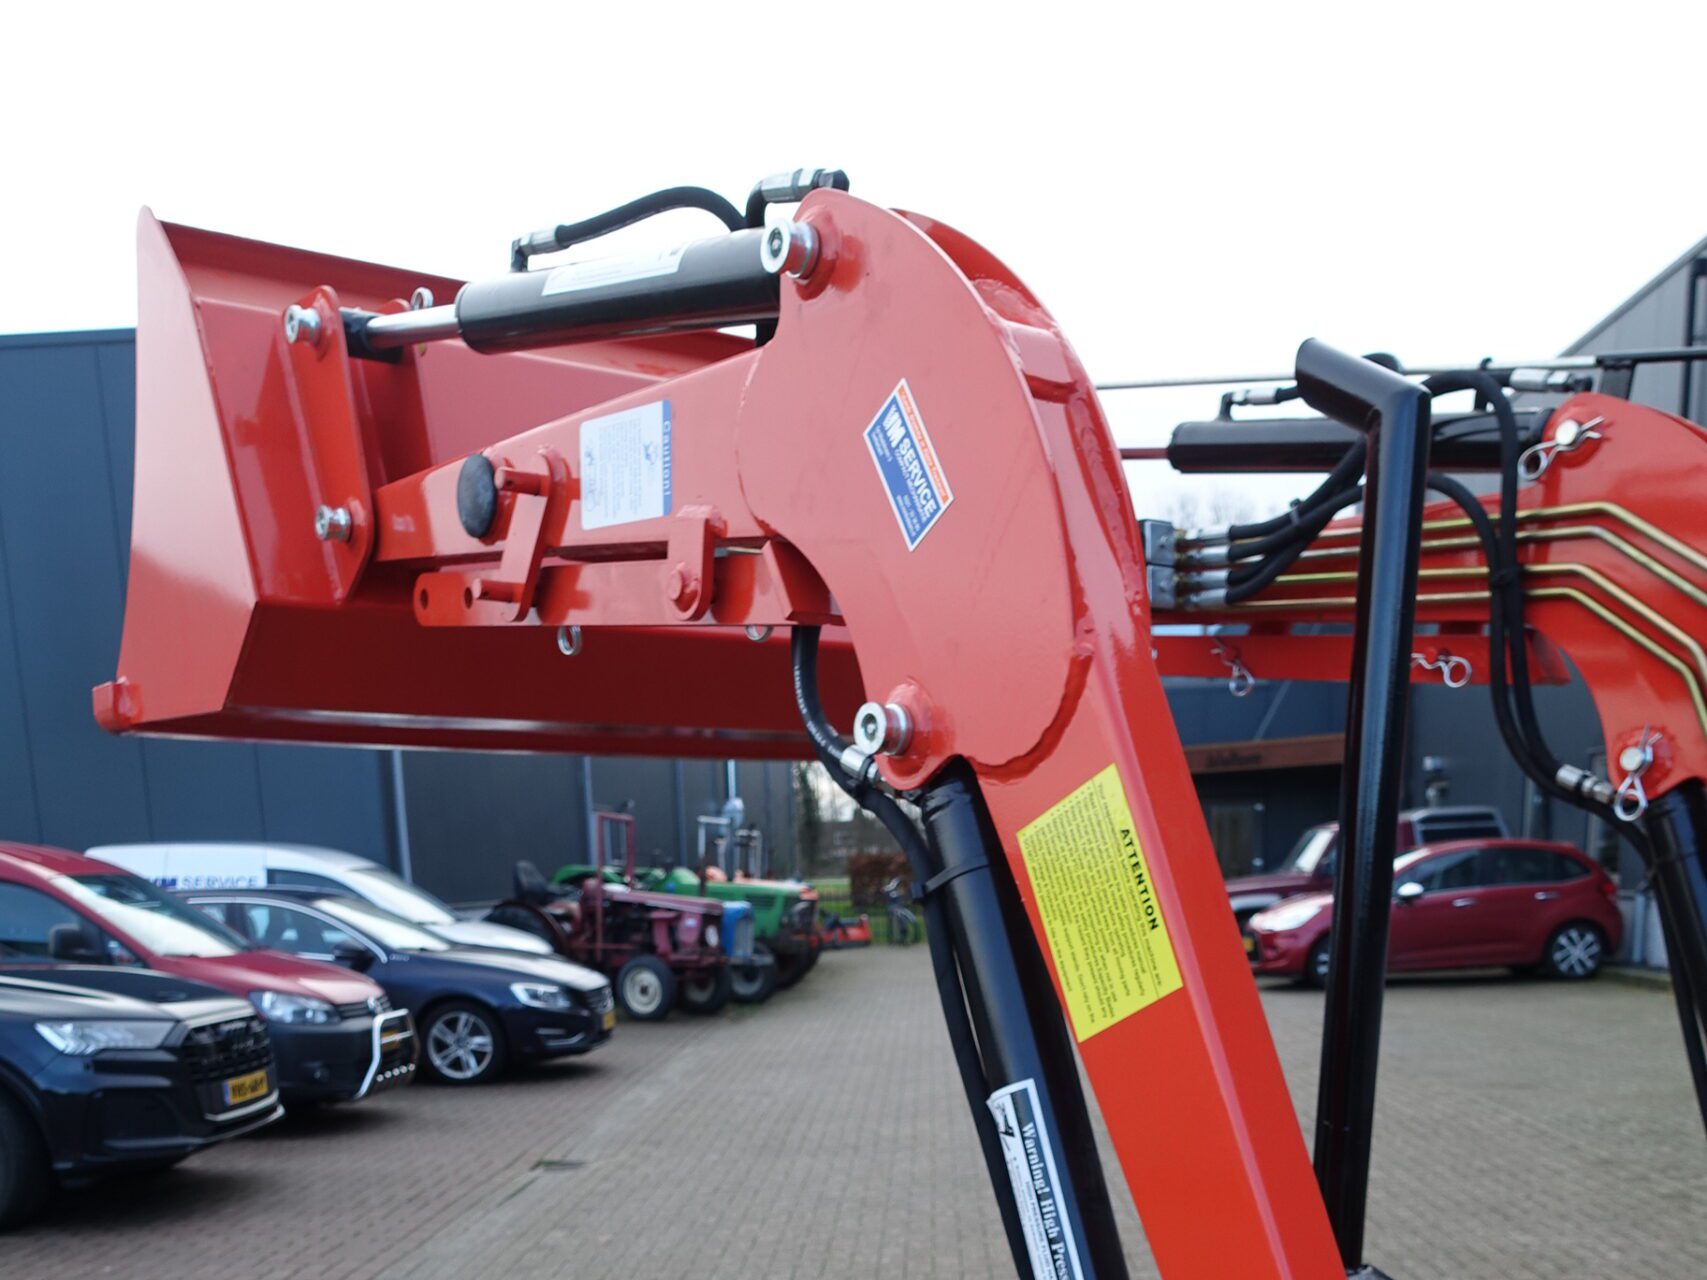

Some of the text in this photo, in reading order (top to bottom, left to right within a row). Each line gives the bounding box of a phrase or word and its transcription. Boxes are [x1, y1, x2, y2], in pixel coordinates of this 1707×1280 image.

[898, 437, 937, 518] SERVICE
[1119, 828, 1159, 931] ATTENTION
[1021, 1122, 1049, 1199] Warning!
[1039, 1198, 1059, 1240] High
